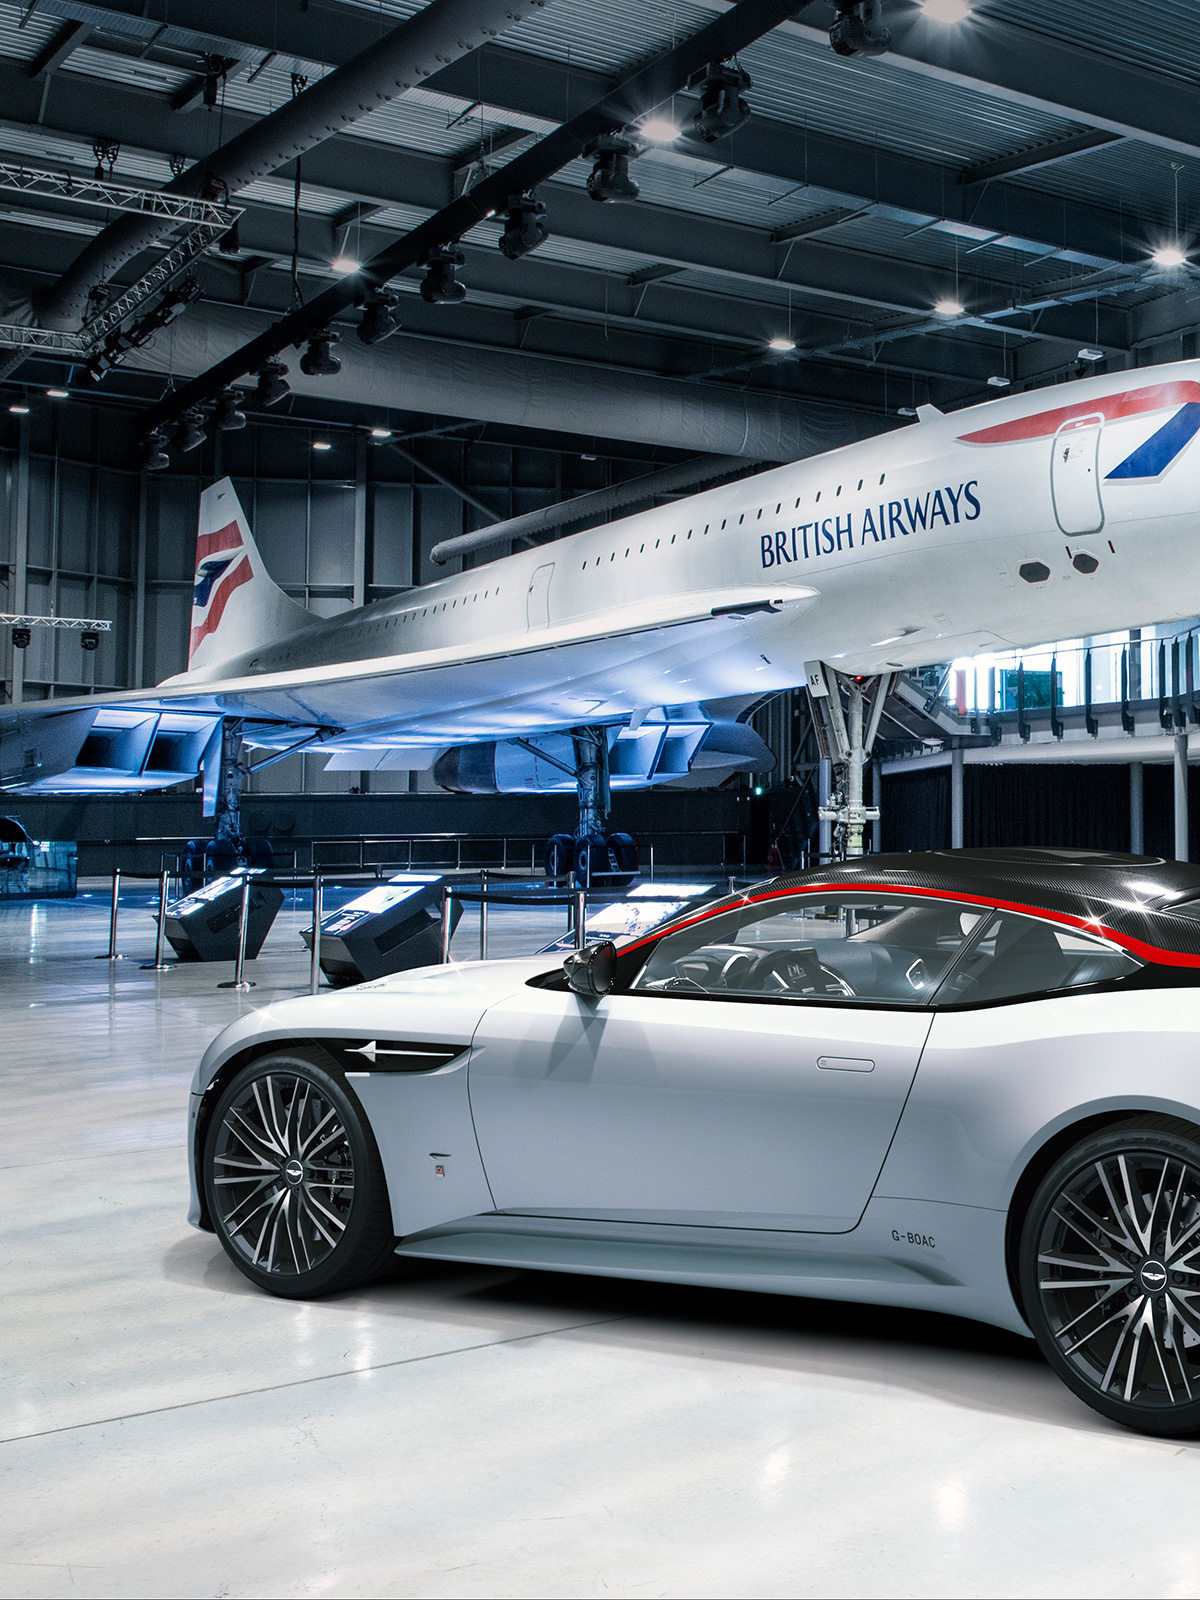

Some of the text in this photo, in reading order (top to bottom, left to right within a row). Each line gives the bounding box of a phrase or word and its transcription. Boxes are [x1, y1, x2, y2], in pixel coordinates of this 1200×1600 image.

[760, 480, 981, 569] BRITISH AIRWAYS
[810, 674, 820, 686] AF
[891, 1229, 936, 1248] G-BOAC
